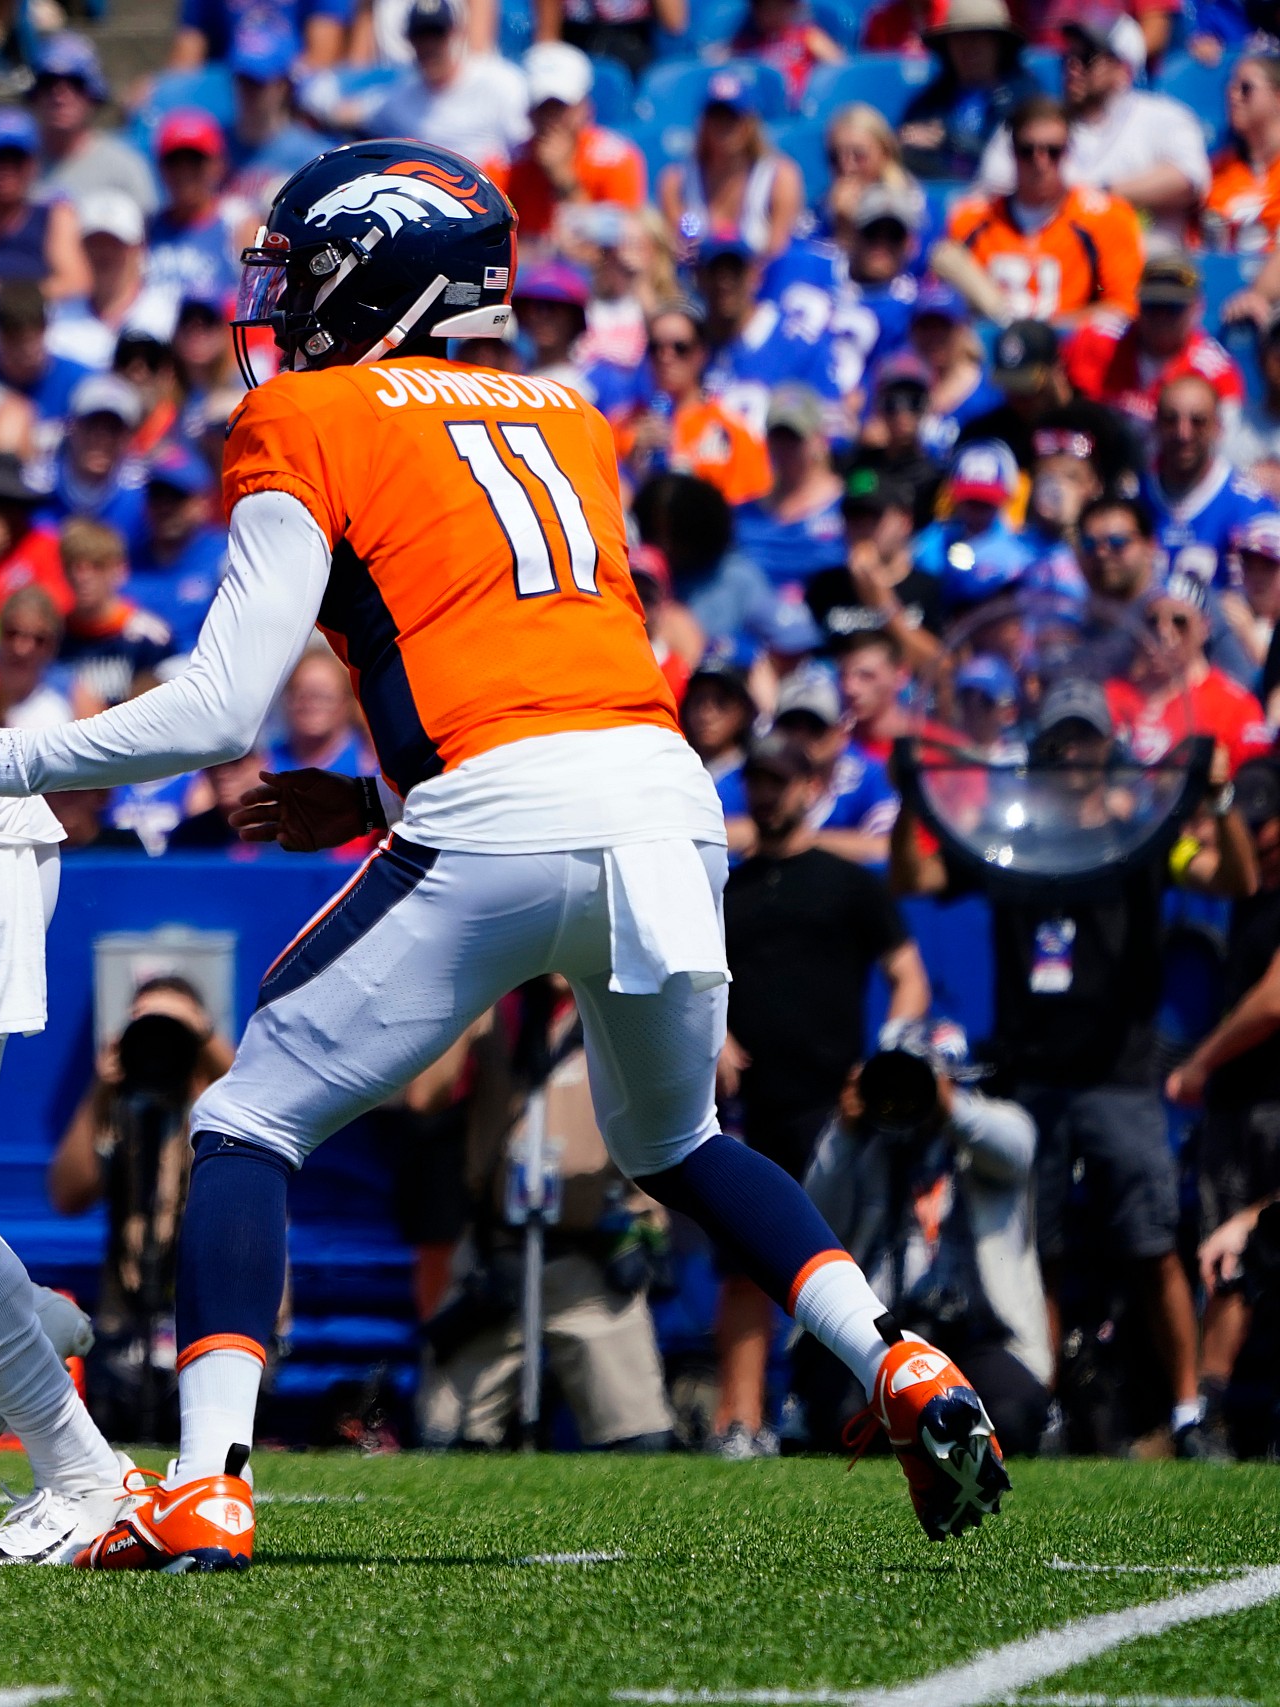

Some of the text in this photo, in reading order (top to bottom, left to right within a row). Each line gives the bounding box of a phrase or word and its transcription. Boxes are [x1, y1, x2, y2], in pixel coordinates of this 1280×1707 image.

[369, 366, 577, 410] JOHNSON
[443, 420, 602, 600] 11
[106, 1534, 138, 1556] ALPHA
